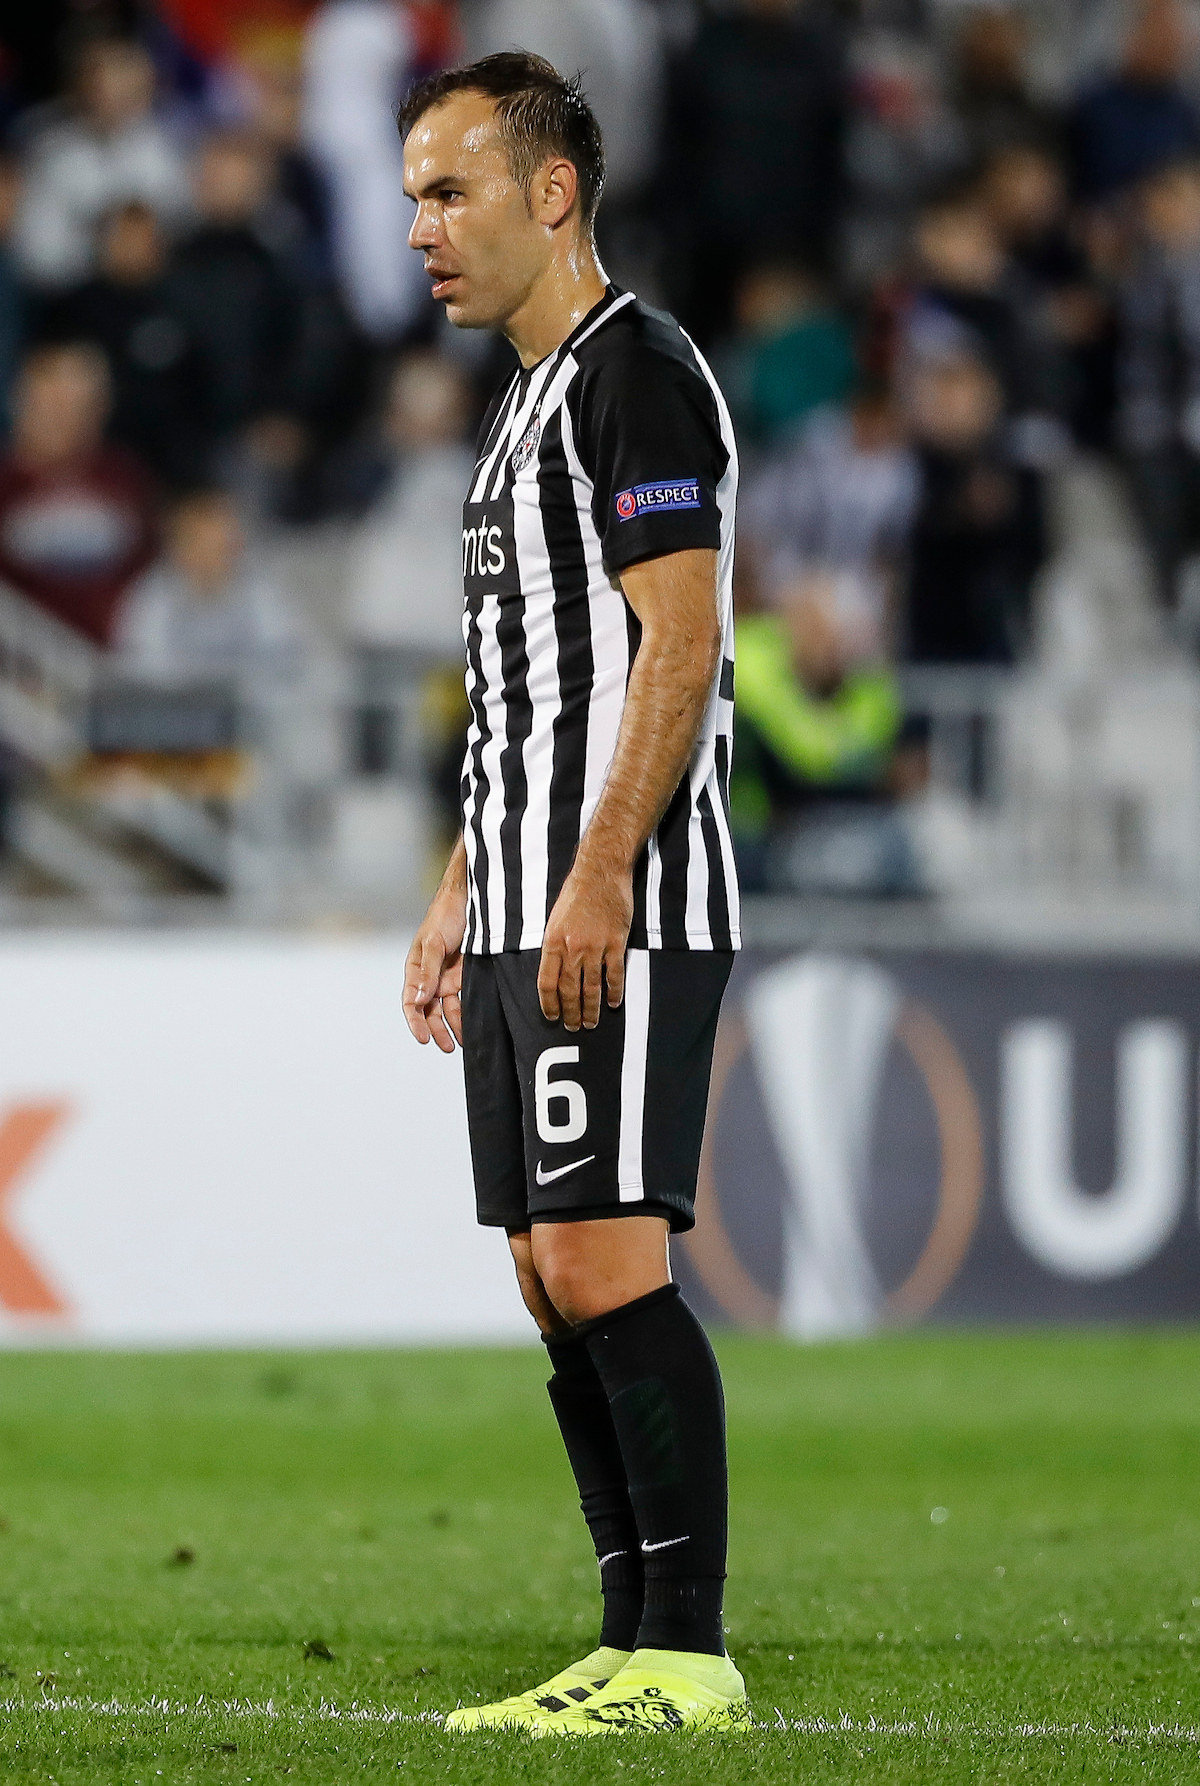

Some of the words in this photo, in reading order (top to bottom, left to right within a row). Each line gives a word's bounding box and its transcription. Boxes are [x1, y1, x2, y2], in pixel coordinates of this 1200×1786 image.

[637, 486, 699, 507] RESPECT
[462, 514, 506, 576] mts
[535, 1046, 587, 1144] 6
